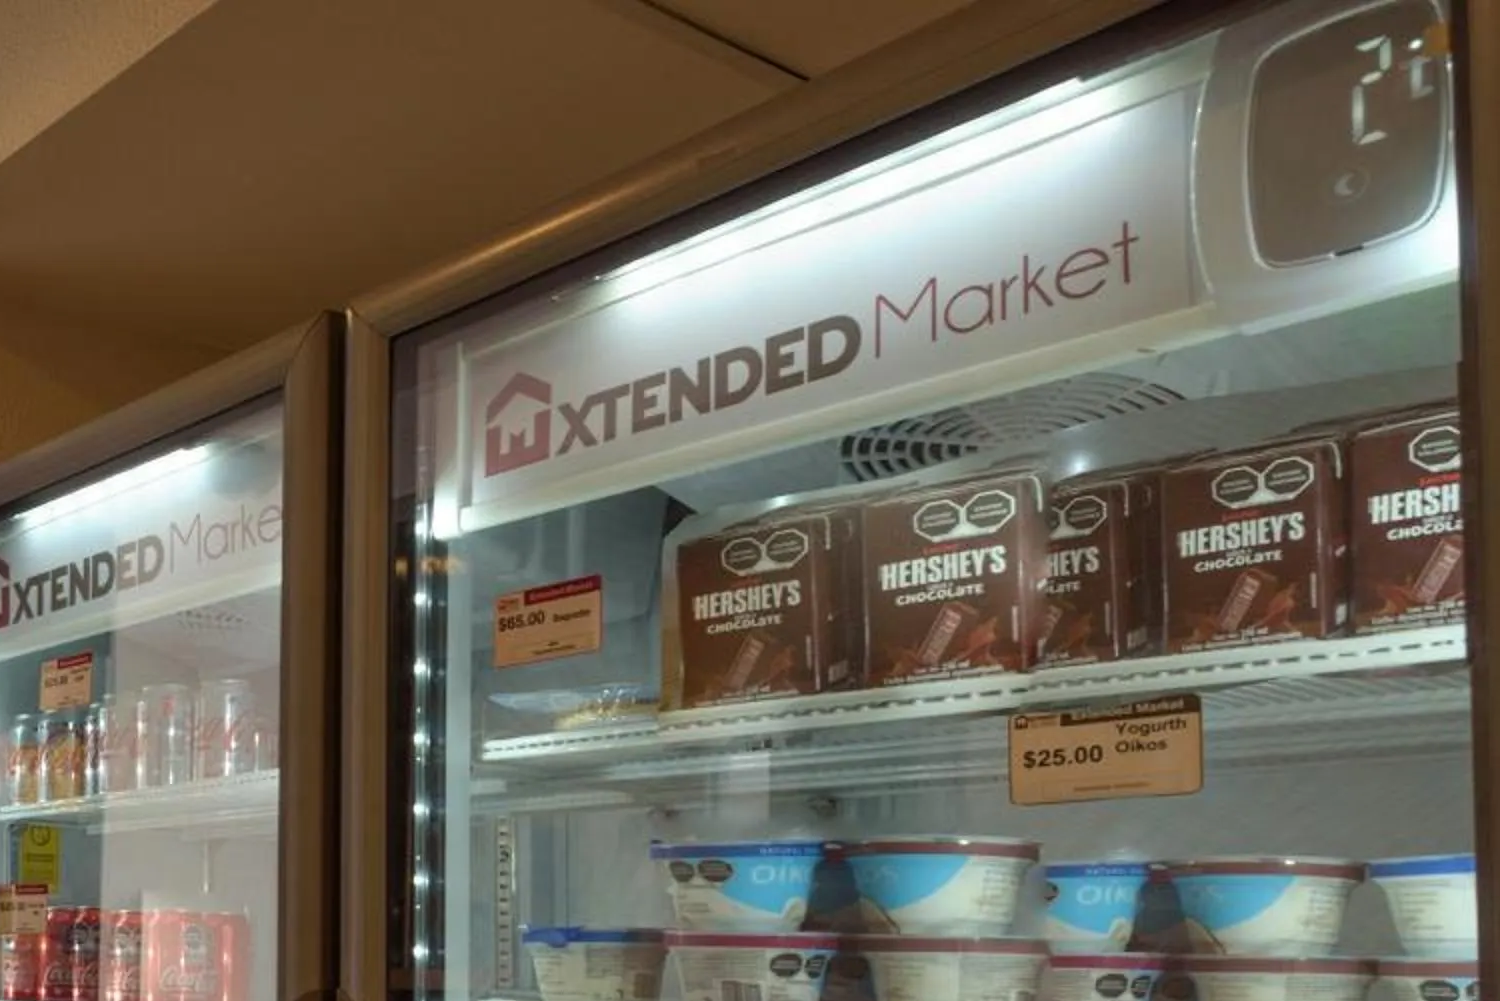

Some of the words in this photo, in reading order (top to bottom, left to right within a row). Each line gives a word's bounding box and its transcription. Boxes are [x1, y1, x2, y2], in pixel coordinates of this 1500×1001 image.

[873, 220, 1141, 360] Market
[1367, 483, 1460, 524] HERSH
[1178, 511, 1305, 558] HERSHEY'S
[878, 544, 1008, 591] HERSHEY'S
[1193, 549, 1283, 573] CHOCOLATE
[692, 579, 802, 621] HERSHEY'S
[894, 582, 985, 607] CHOCOLATE
[706, 613, 782, 635] CHOCOLATE
[1114, 717, 1188, 737] Yogurth
[1022, 744, 1103, 769] $25.00
[1114, 738, 1168, 753] Oikos
